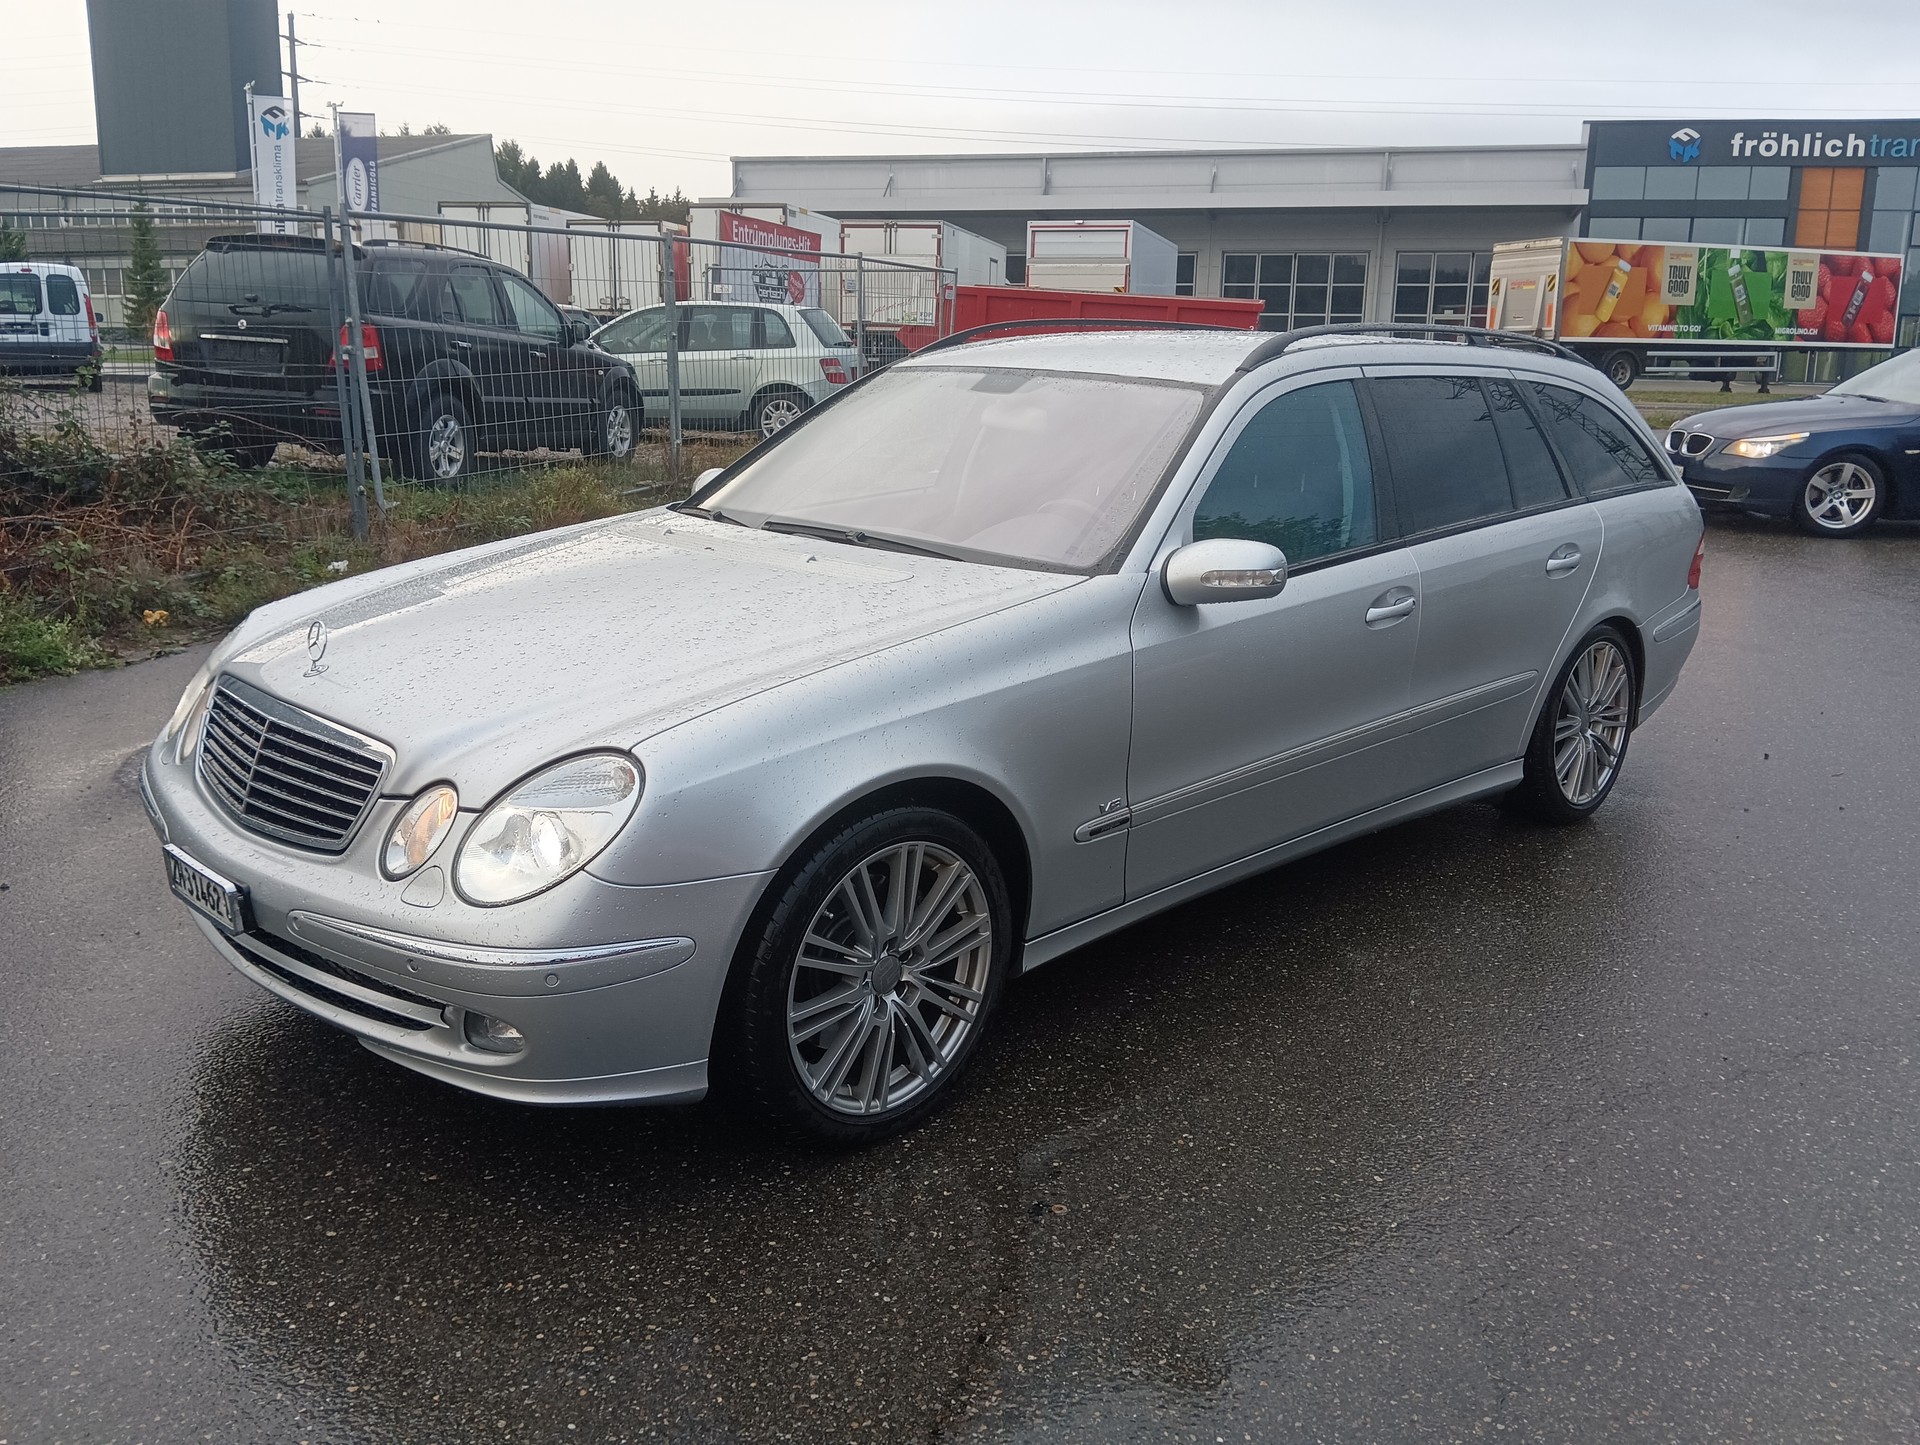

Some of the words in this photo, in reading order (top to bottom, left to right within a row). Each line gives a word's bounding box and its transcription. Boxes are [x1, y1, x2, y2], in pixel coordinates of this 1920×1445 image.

[1730, 131, 1866, 157] fröhlich
[273, 145, 284, 203] transklima
[353, 165, 361, 207] Carrier
[369, 160, 378, 213] TRANSICOLD
[1669, 265, 1692, 280] TRULY
[1792, 271, 1813, 285] TRULY
[1668, 280, 1690, 294] GOOD
[1791, 285, 1811, 298] GOOD
[1648, 324, 1678, 332] VITAMINE
[1690, 325, 1701, 333] GO!
[1775, 327, 1818, 335] MIGROLINO.CH
